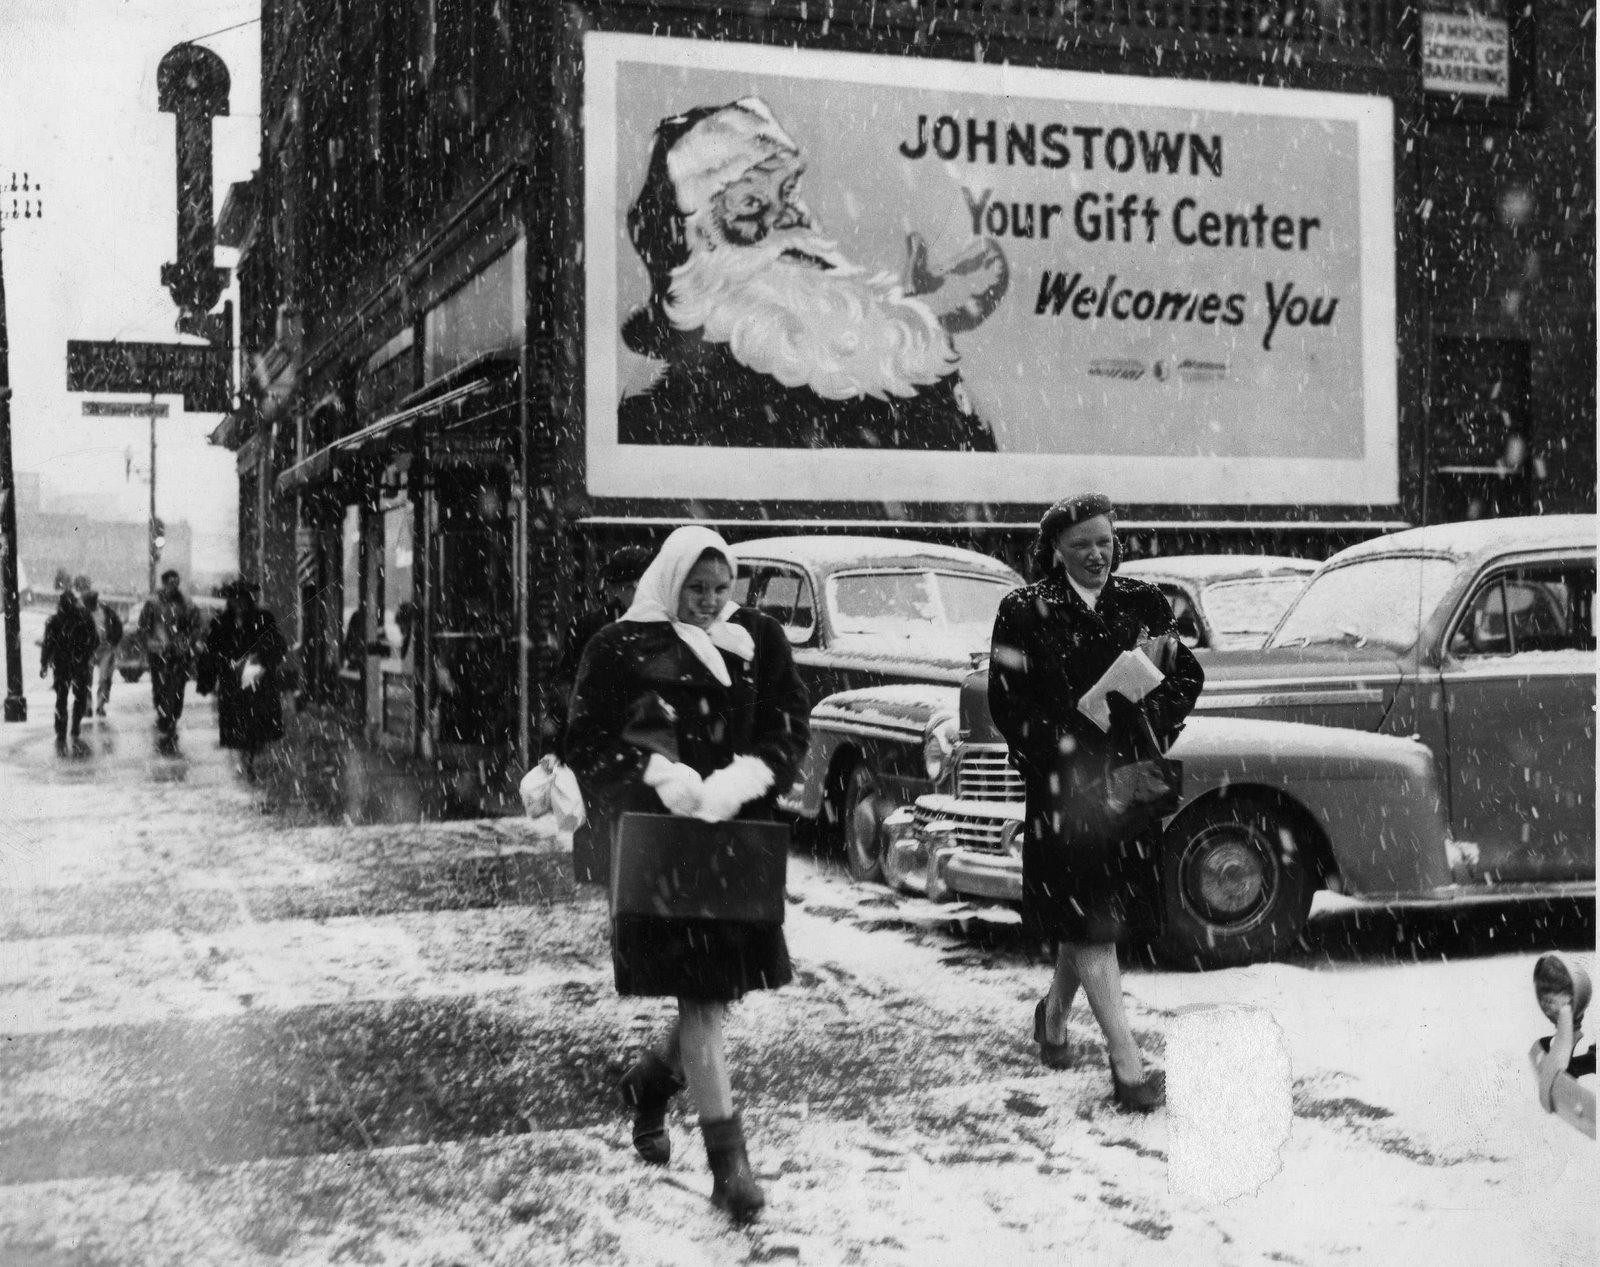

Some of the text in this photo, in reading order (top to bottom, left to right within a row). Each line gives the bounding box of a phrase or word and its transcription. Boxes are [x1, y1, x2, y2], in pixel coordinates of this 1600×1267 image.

[1423, 41, 1505, 64] SCHOOL OF
[1423, 62, 1505, 87] BARBERING
[899, 114, 1223, 177] JOHNSTOWN
[961, 185, 1320, 251] Your Gift Center
[1034, 271, 1339, 351] Welcomes You
